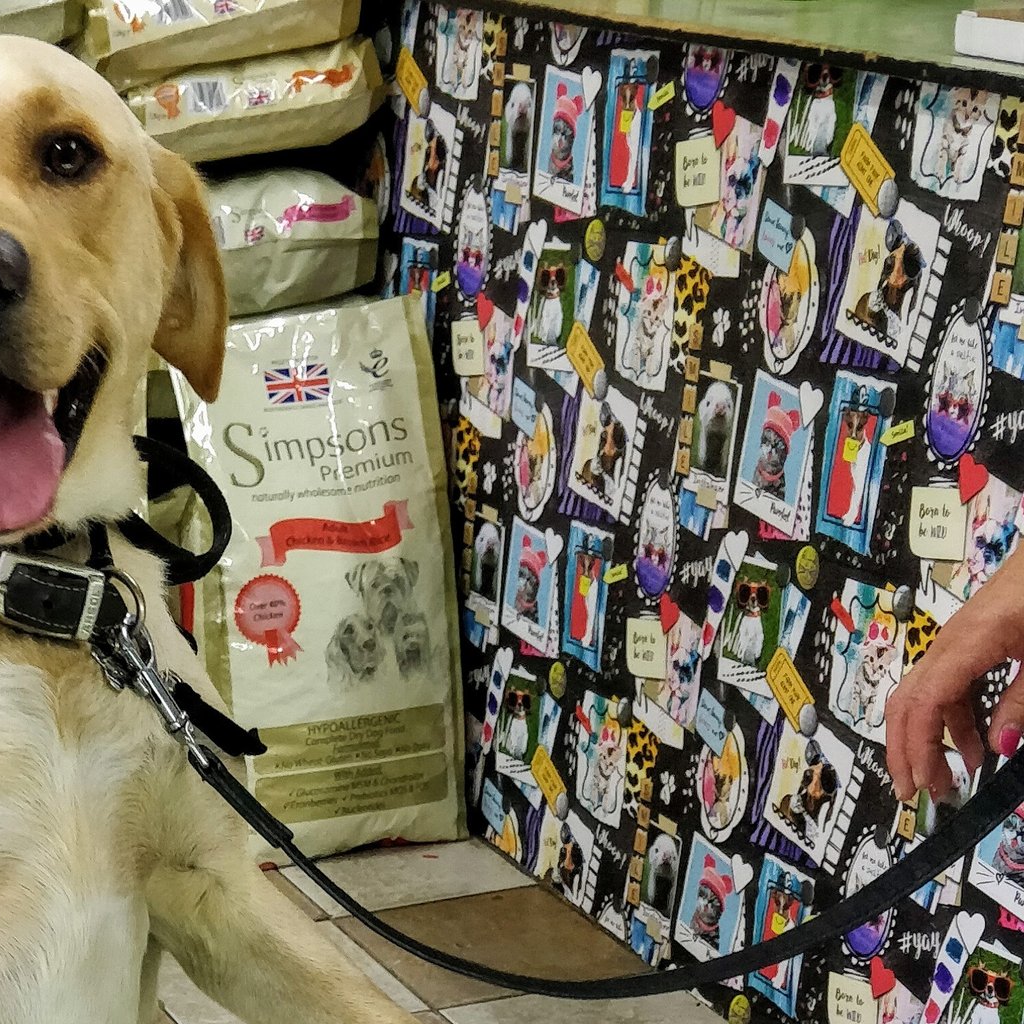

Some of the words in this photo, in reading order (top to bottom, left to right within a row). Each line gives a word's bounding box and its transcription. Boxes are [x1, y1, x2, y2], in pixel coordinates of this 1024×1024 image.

[943, 202, 994, 259] Whoop!
[223, 416, 409, 488] Simpsons
[320, 450, 414, 483] Premium
[251, 489, 296, 503] naturally
[297, 485, 353, 500] wholesome
[353, 473, 402, 494] nutrition
[919, 503, 939, 519] Born
[941, 503, 951, 519] to
[918, 522, 927, 538] be
[285, 535, 326, 549] Chicken
[248, 601, 268, 611] Over
[253, 610, 284, 622] Chicken
[306, 712, 402, 736] HYPOALLERGENIC
[305, 734, 348, 746] Complete
[349, 731, 364, 742] Dry
[897, 930, 942, 960] #yay
[835, 988, 853, 1003] Born
[856, 993, 864, 1006] to
[836, 1004, 843, 1016] be
